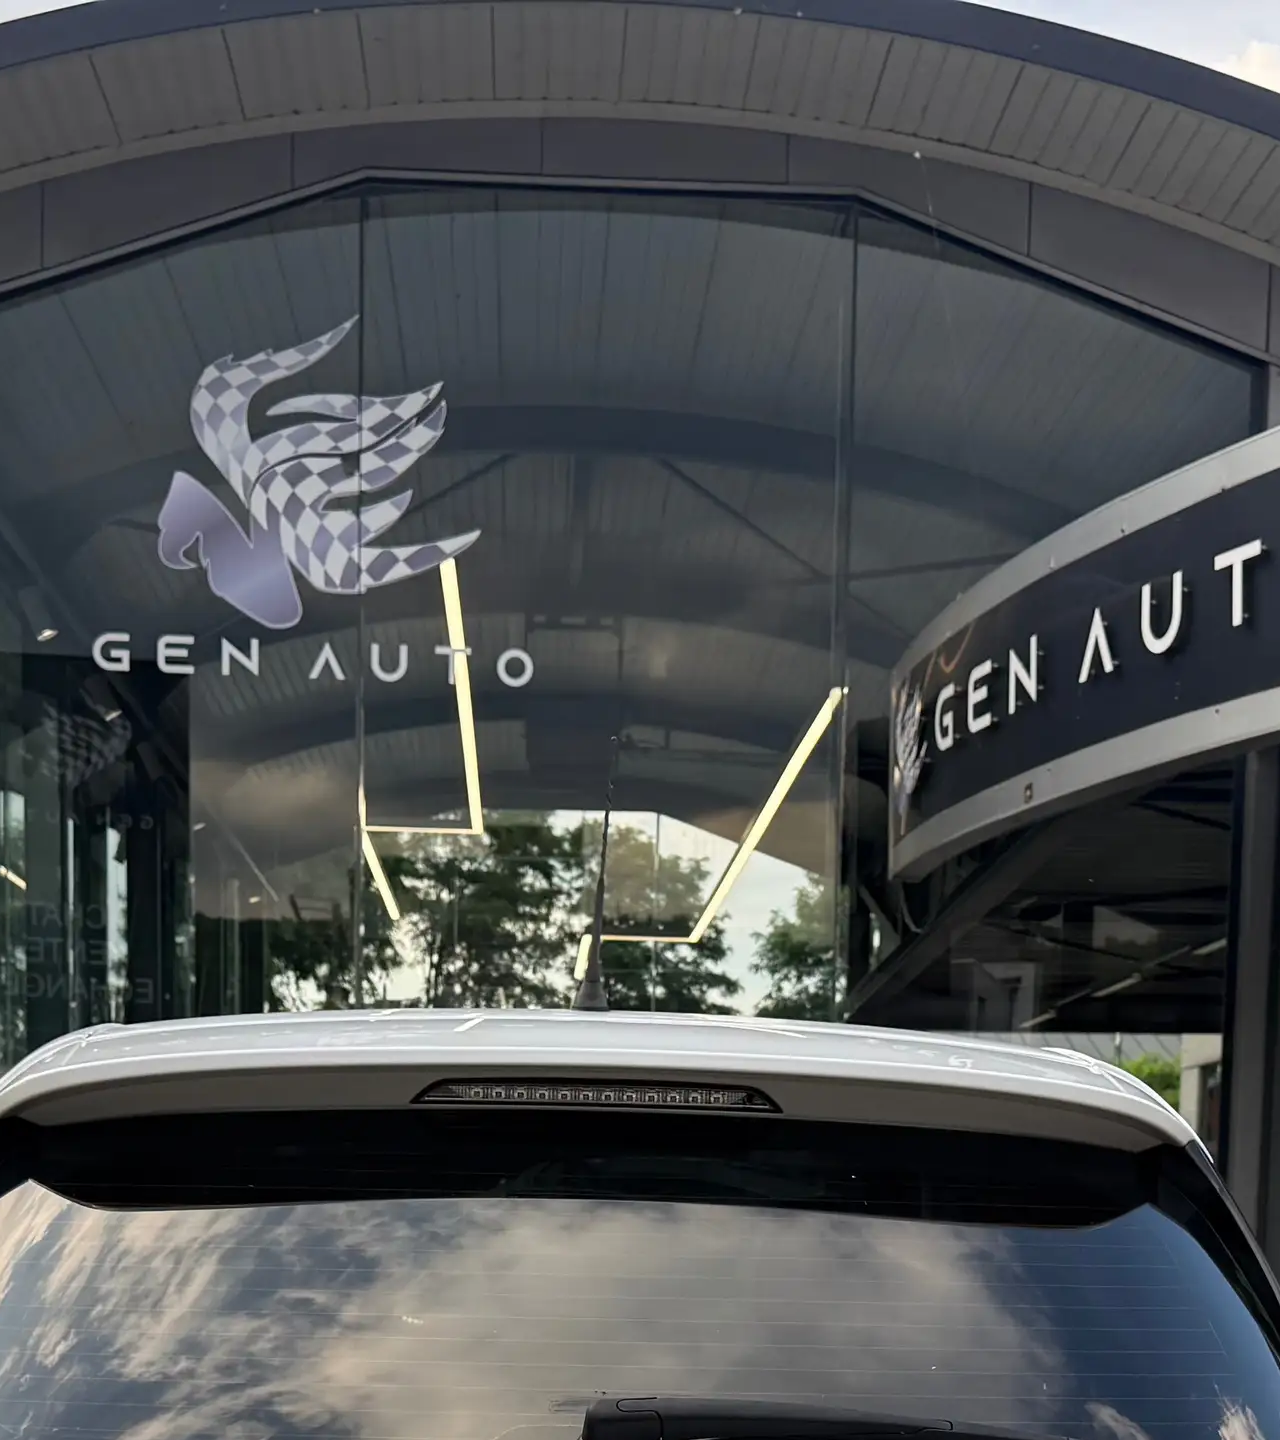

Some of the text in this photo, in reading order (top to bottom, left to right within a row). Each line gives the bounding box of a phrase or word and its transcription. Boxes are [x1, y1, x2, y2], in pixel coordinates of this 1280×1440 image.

[91, 632, 535, 688] GEN AUTO
[933, 634, 1038, 752] GEN
